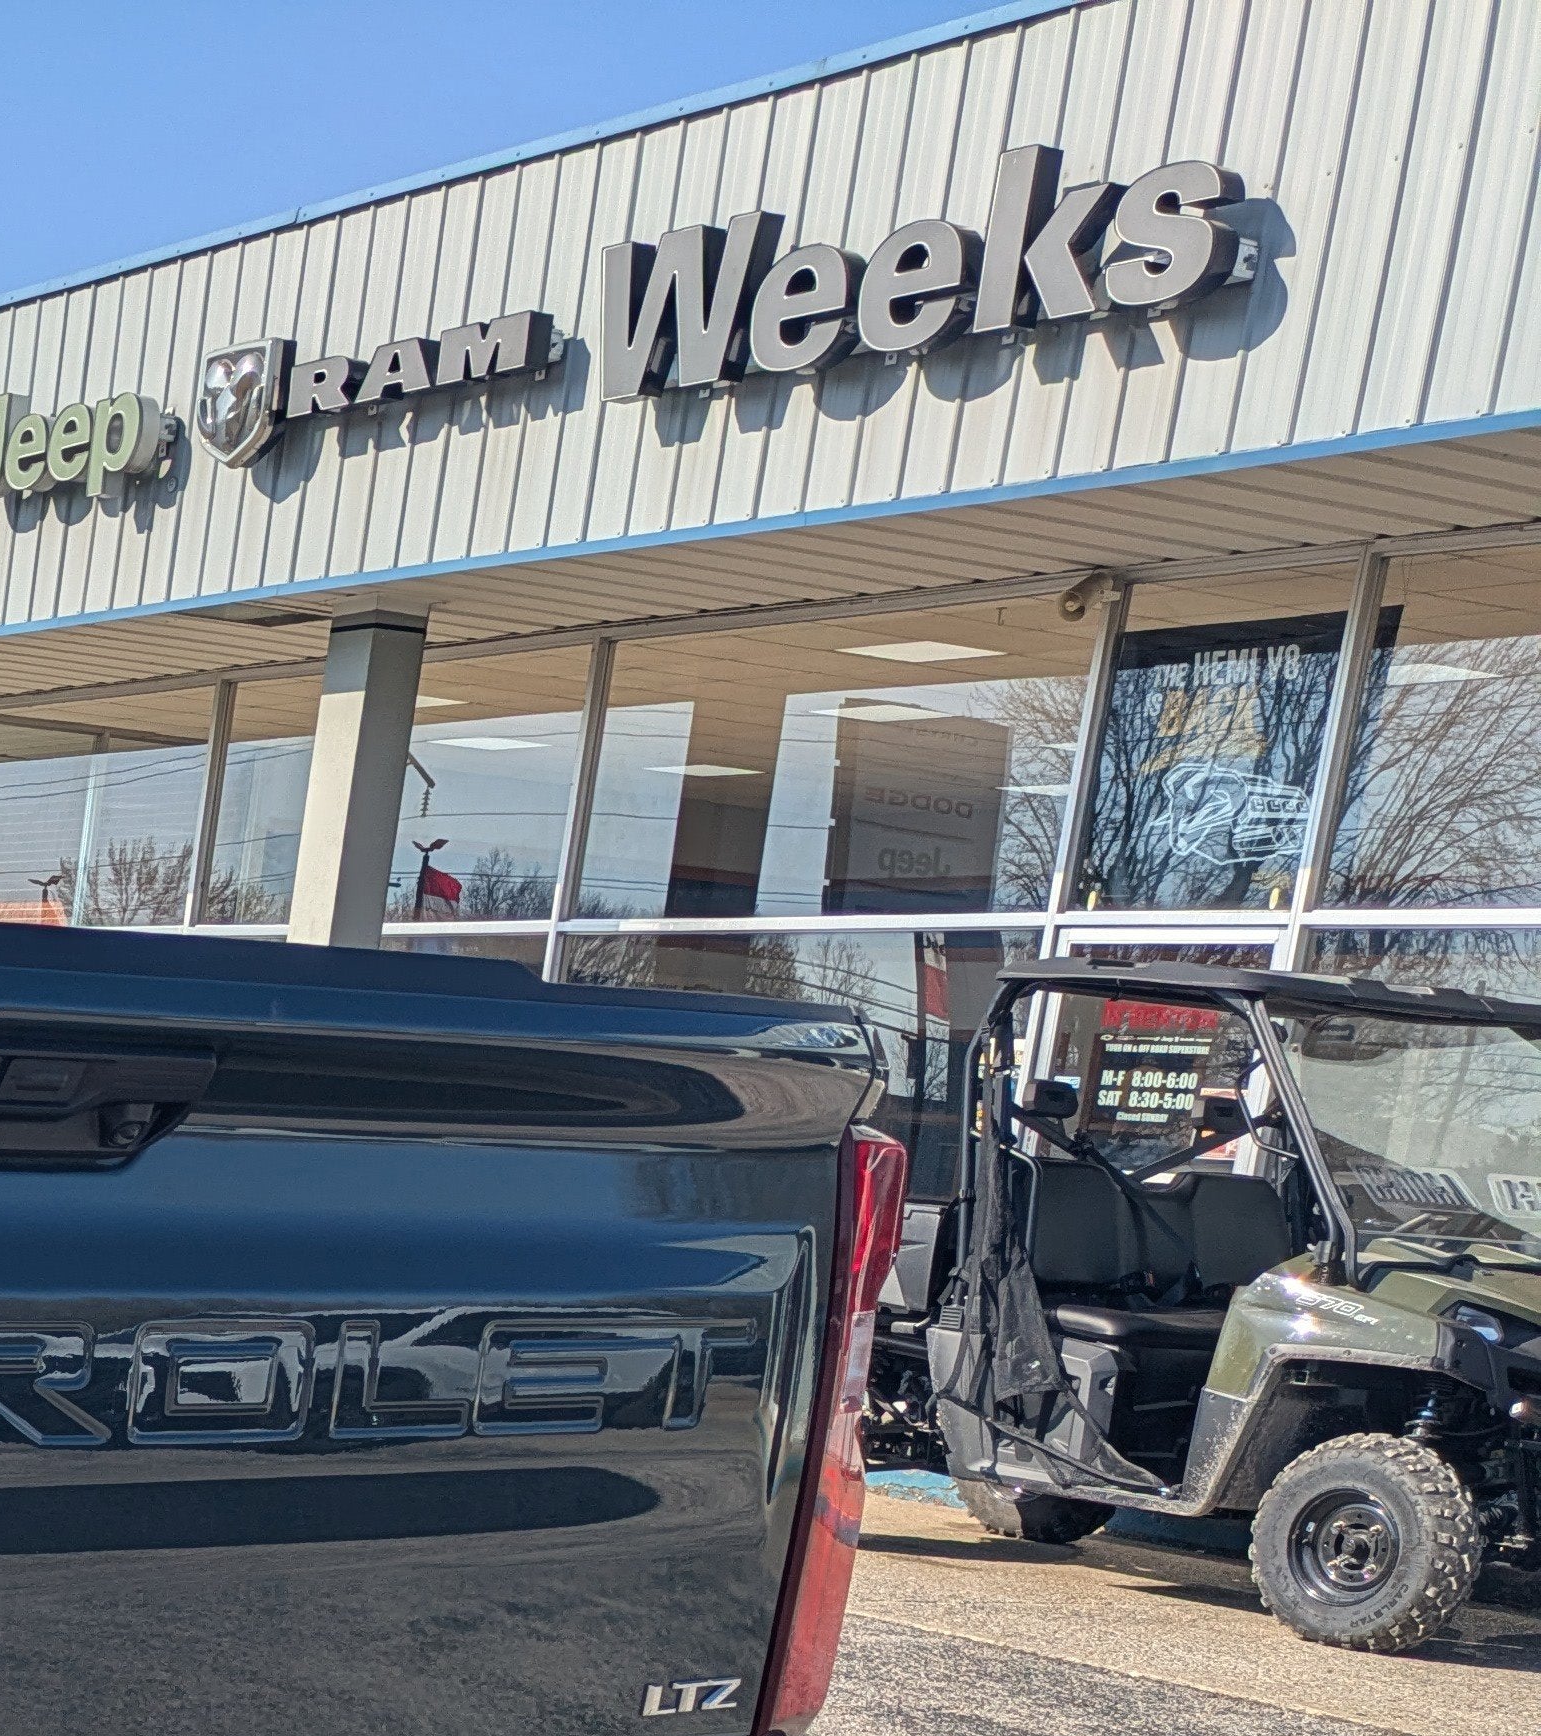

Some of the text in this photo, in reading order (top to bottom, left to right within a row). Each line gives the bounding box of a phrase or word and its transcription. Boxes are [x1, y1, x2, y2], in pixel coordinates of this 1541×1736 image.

[601, 143, 1235, 401] Weeks
[286, 309, 549, 418] RAM
[1154, 644, 1301, 688] THE HEMI V8
[1097, 1090, 1123, 1106] SAT
[1128, 1091, 1195, 1110] 8:30-5:00
[1100, 1070, 1198, 1090] M-F 8:00-6:00
[641, 1678, 741, 1717] LTZ
